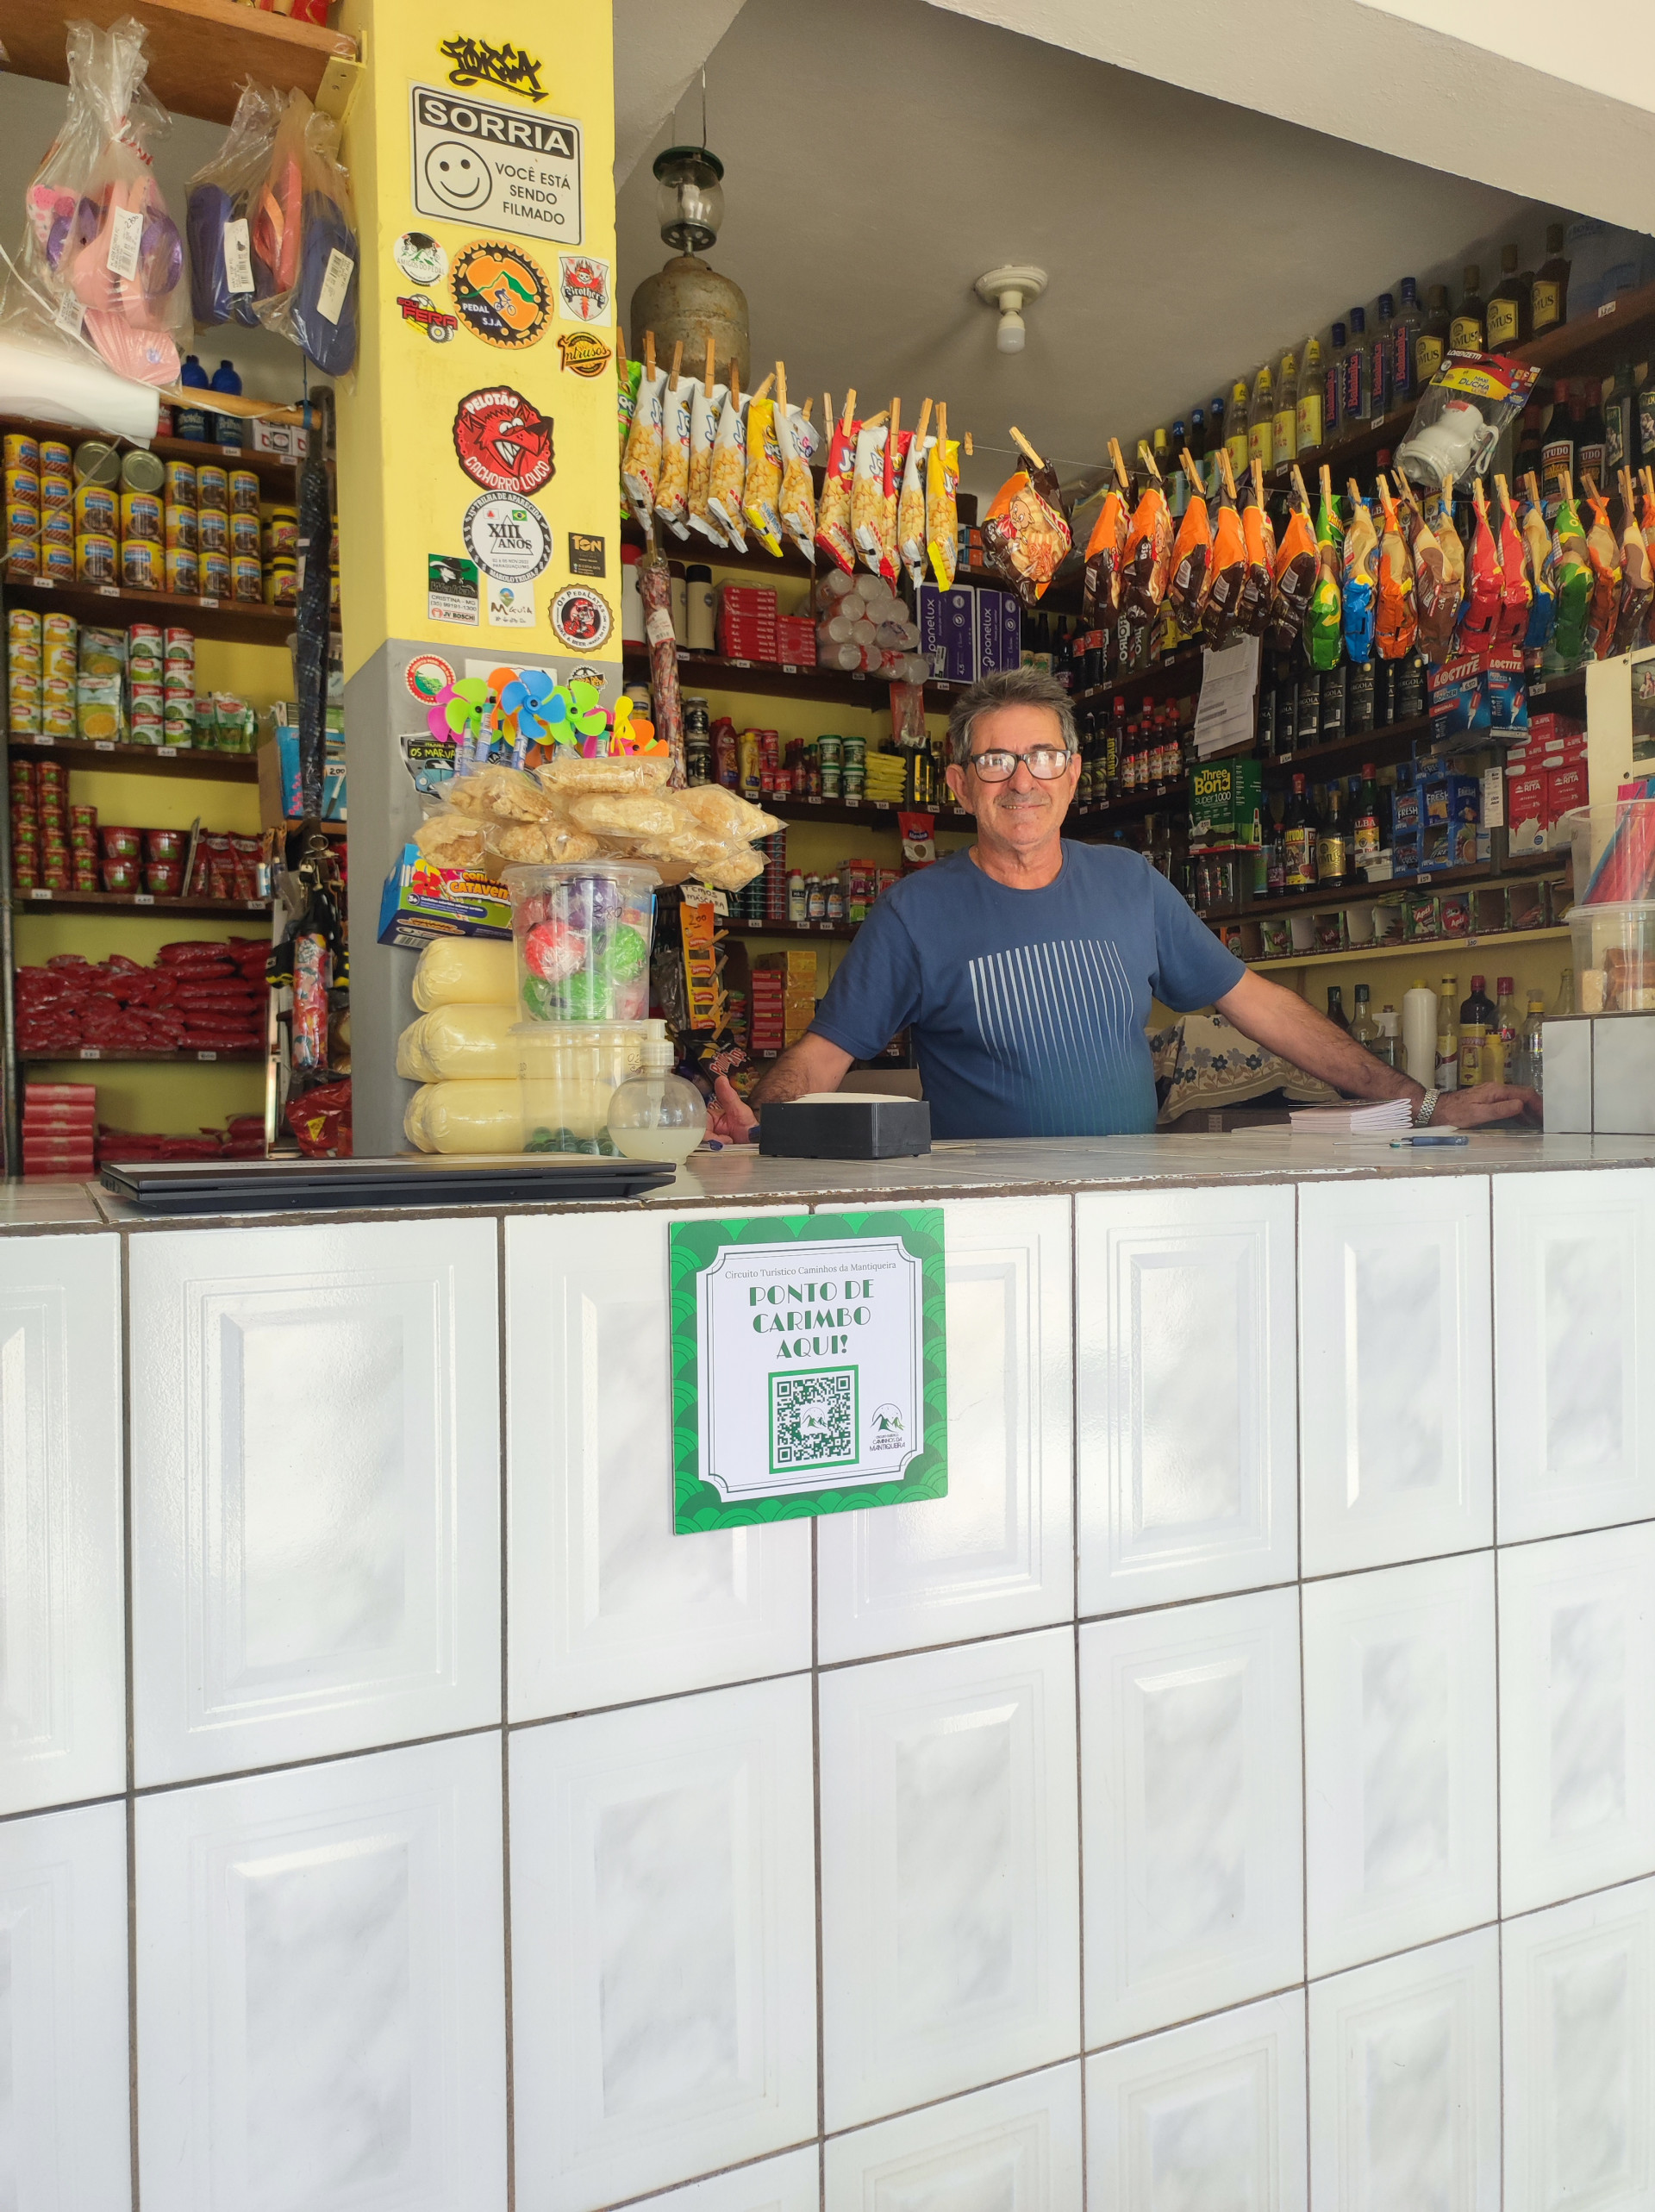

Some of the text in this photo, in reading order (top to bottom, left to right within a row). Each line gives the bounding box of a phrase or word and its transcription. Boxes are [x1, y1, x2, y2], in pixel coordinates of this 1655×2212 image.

[424, 99, 571, 156] SORRIA
[495, 161, 571, 191] VOCÊ ESTÁ
[509, 184, 558, 205] SENDO
[503, 202, 565, 225] FILMADO
[397, 259, 419, 270] AMIGOS
[428, 264, 445, 275] PEDAL
[397, 297, 419, 308] SOU
[564, 284, 606, 303] Brothers
[403, 306, 459, 330] FERA
[462, 303, 490, 315] PEDAL
[1447, 349, 1483, 360] LORENZETTI
[1348, 353, 1358, 407] Balalaika
[1458, 378, 1490, 391] DUCHA
[465, 392, 519, 414] PELOTÃO
[465, 456, 551, 491] CACHORRO LOUCO
[475, 492, 497, 507] TRILHA
[508, 493, 542, 521] APARECIDA
[487, 523, 521, 539] XIII
[498, 539, 533, 550] ANOS
[571, 534, 602, 553] TON
[432, 595, 460, 603] CRISTINA
[925, 598, 937, 652] panelux
[983, 608, 993, 656] panelux
[1135, 626, 1144, 655] ORL
[1433, 659, 1480, 688] LOCTITE
[1490, 659, 1521, 670] LOCTITE
[1434, 690, 1457, 702] BONDER
[410, 747, 455, 759] OS MARVA
[1195, 772, 1231, 796] Bond
[1202, 769, 1227, 781] Three
[1195, 790, 1232, 806] super 1000
[1427, 792, 1448, 804] FRESH
[1398, 807, 1418, 819] FRESH
[684, 885, 718, 898] TEMOS
[686, 893, 725, 909] MÁSCARA
[725, 1261, 896, 1279] Circuito Turístico Caminhos da Mantiqueira
[749, 1279, 875, 1306] PONTO DE
[753, 1306, 871, 1334] CARIMBO
[776, 1334, 848, 1359] AQUI!
[870, 1442, 906, 1452] MANTIQUEIRA
